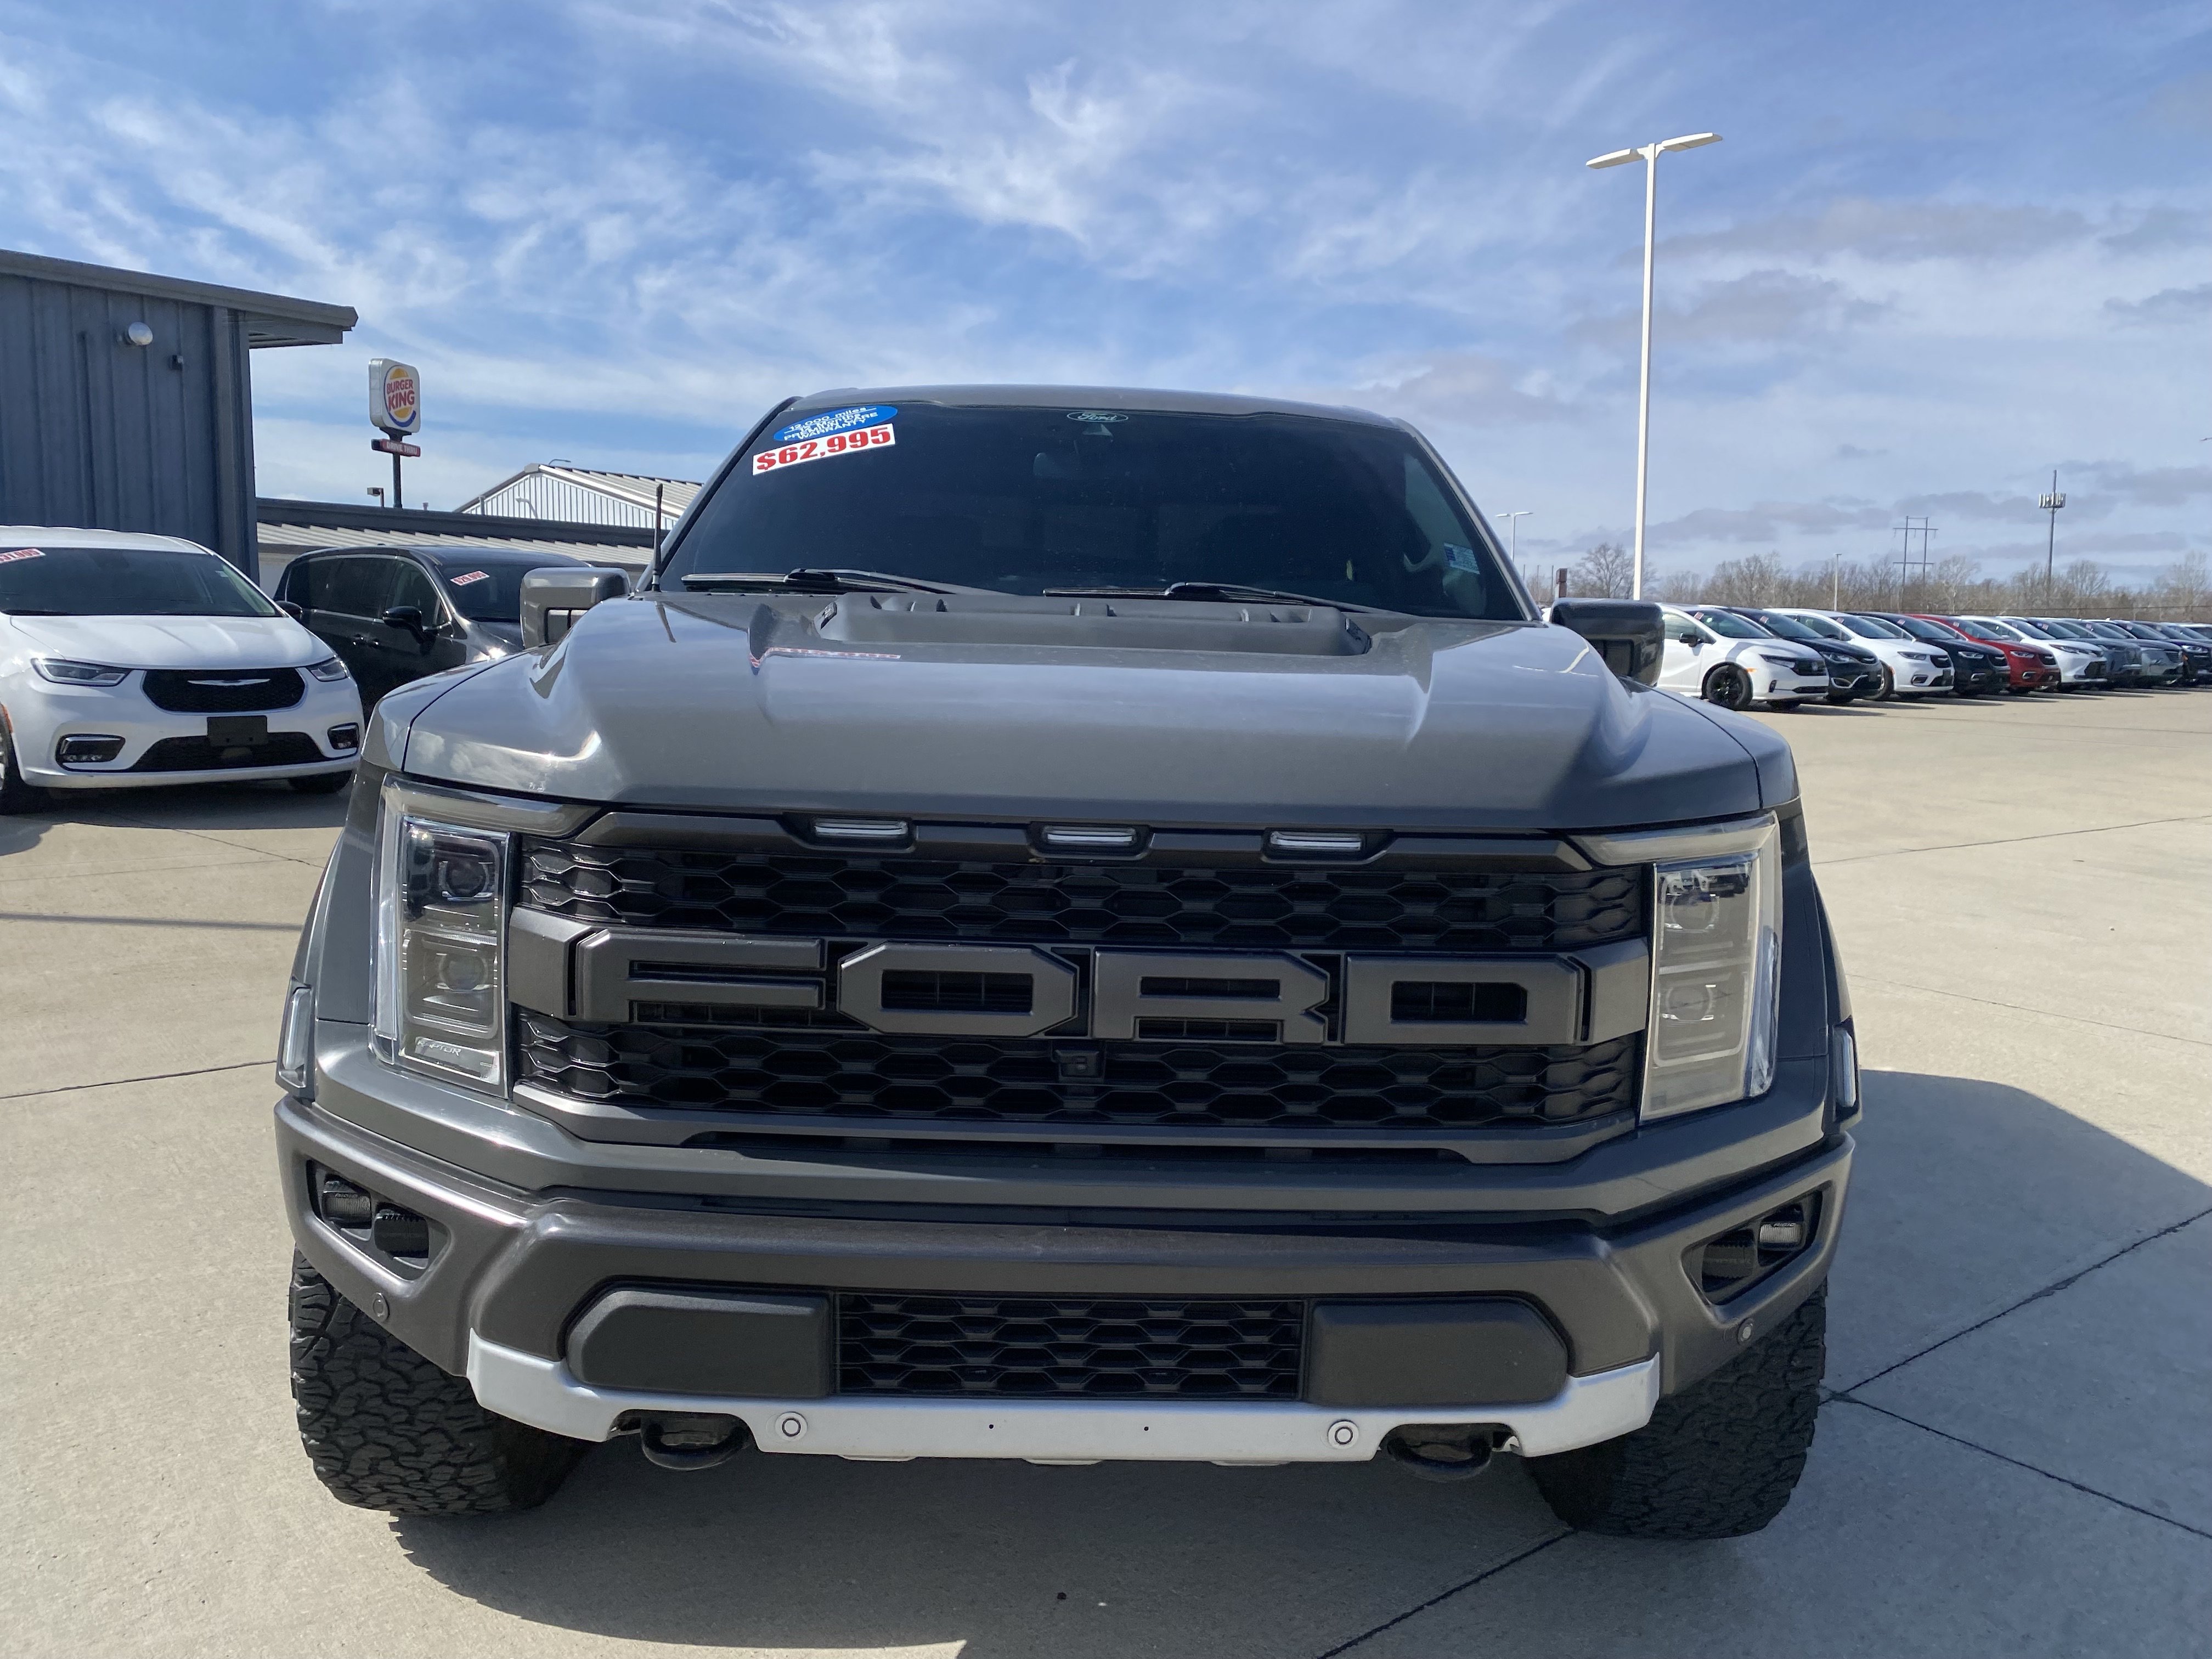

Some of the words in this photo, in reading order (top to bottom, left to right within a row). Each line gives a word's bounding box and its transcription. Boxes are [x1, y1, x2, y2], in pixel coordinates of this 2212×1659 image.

[386, 379, 413, 394] BURGER
[388, 390, 415, 411] KING
[835, 407, 866, 417] miles
[1077, 413, 1118, 421] Ford
[386, 441, 403, 452] DRIVE
[403, 445, 417, 454] THRU
[757, 427, 890, 470] $62,995
[578, 929, 1580, 1044] FORD
